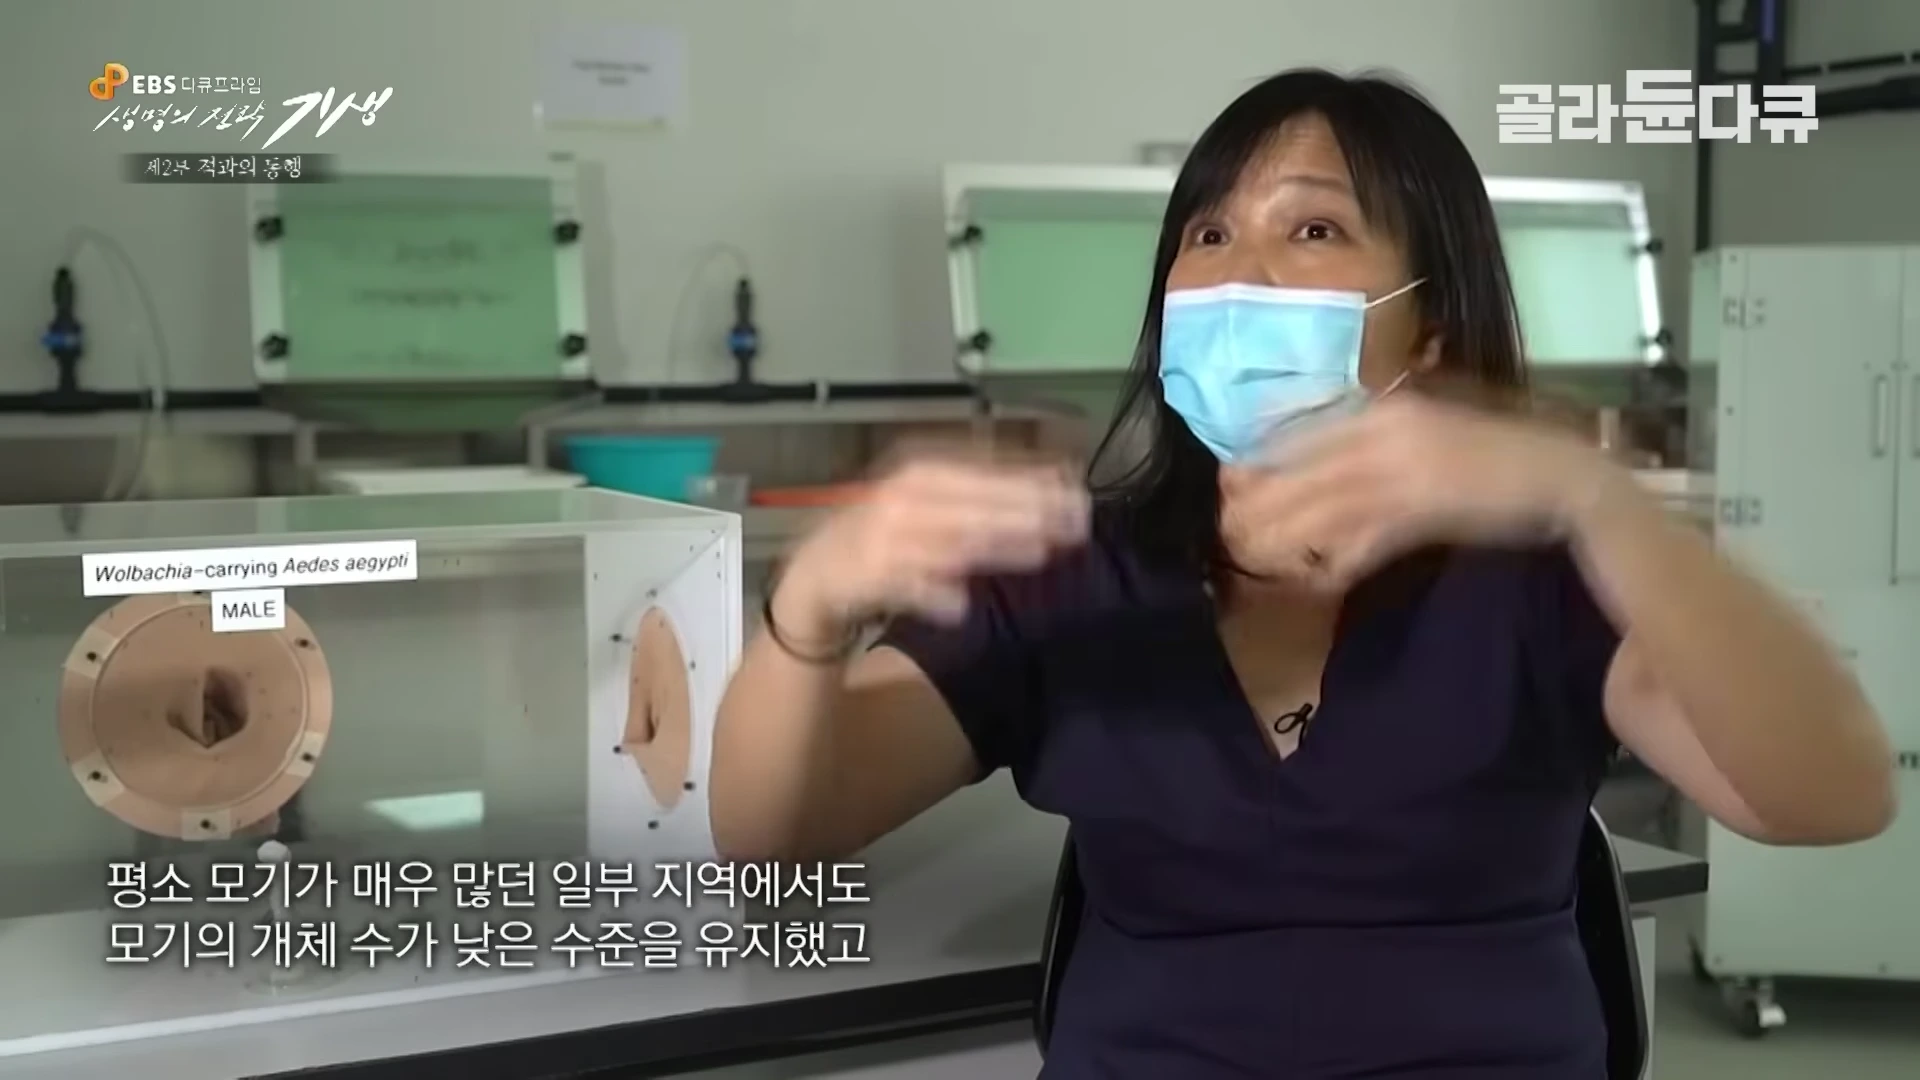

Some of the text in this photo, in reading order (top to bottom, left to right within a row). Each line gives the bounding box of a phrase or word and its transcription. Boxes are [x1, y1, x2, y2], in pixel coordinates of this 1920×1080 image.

[282, 555, 340, 575] Aedes
[344, 551, 410, 573] aegypti
[221, 600, 276, 619] MALE
